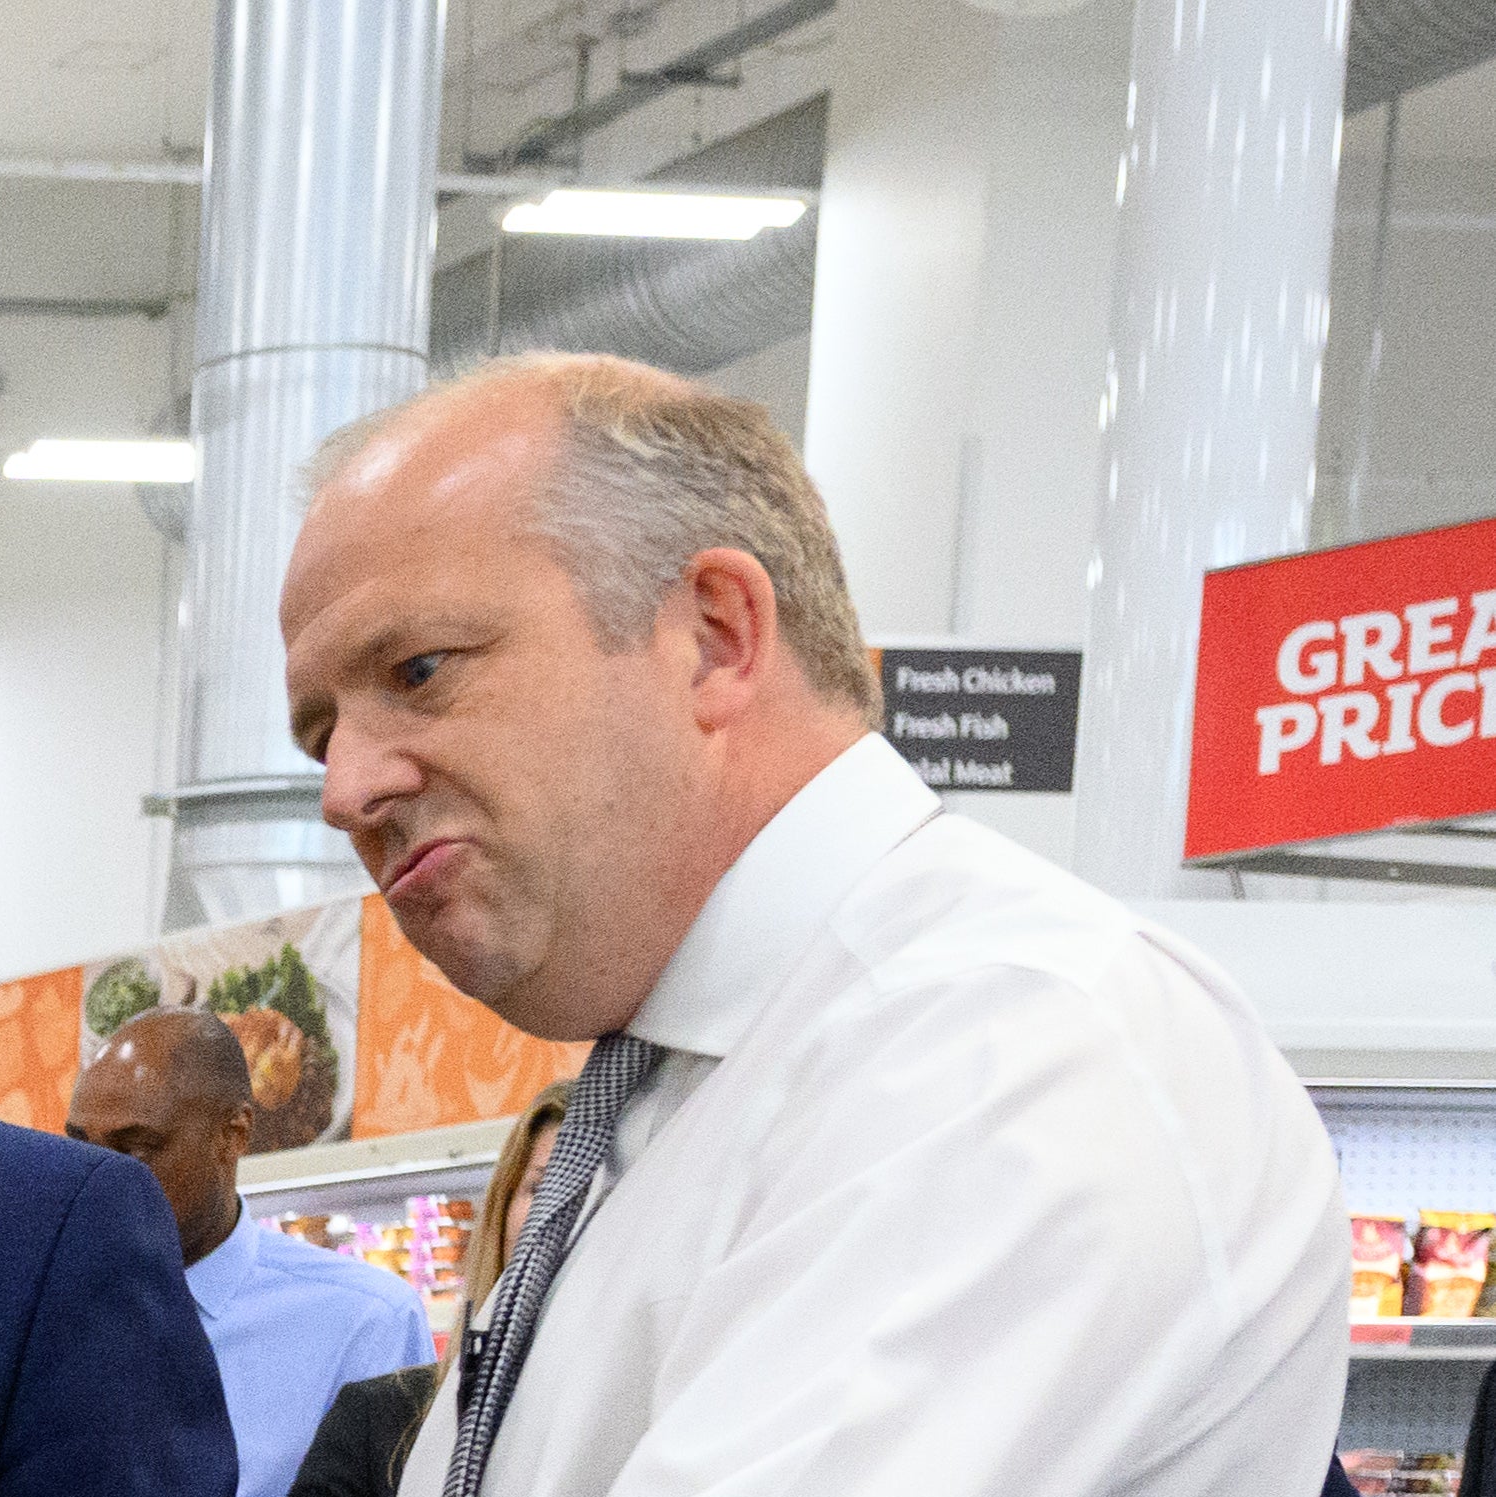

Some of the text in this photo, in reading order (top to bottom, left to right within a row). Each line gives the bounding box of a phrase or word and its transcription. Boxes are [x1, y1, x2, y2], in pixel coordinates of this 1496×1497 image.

[896, 666, 1056, 695] Fresh Chicken
[893, 712, 1009, 740] Fresh Fish
